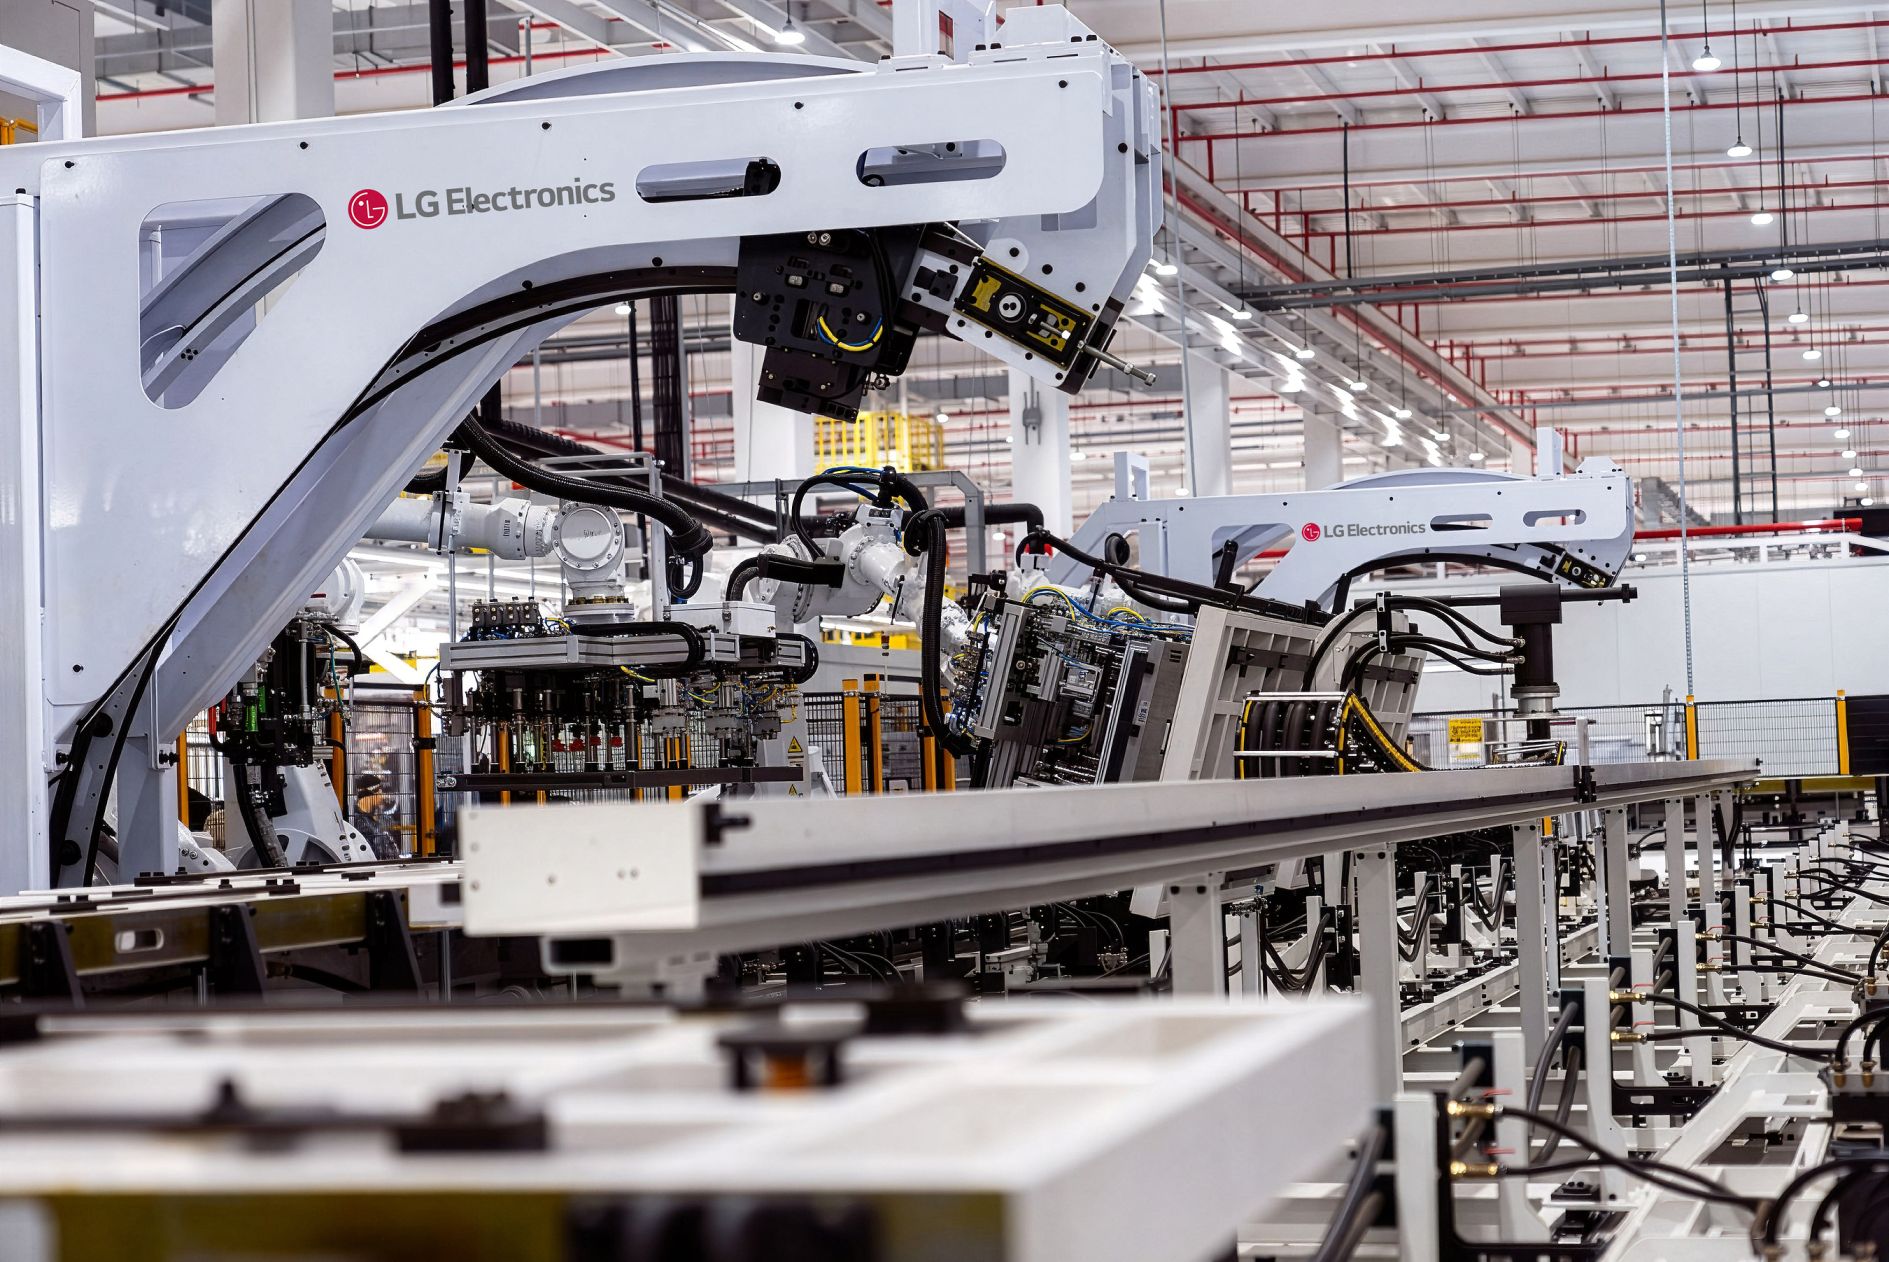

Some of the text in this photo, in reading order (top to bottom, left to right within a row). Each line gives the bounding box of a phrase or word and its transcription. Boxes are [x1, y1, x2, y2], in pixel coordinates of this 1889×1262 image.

[395, 190, 440, 220] LG
[446, 177, 616, 216] Electronics
[1324, 524, 1345, 538] LG
[1347, 521, 1426, 537] Electronics
